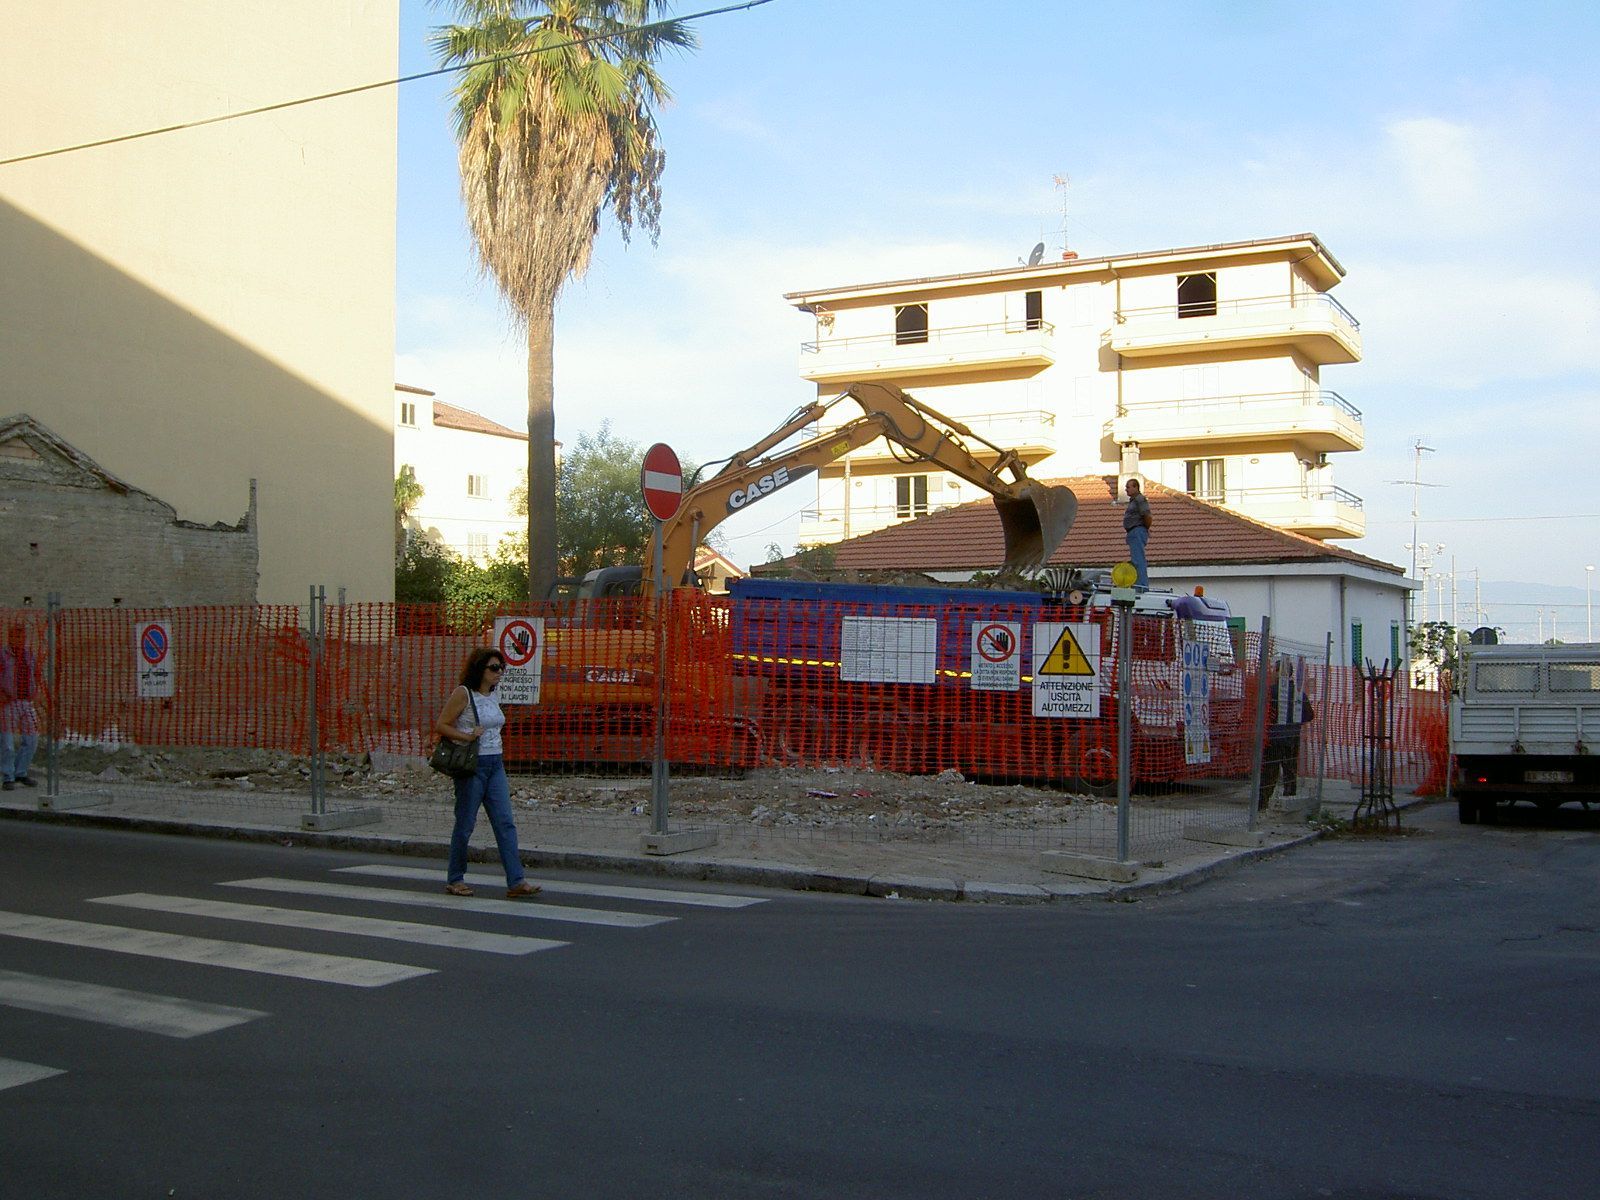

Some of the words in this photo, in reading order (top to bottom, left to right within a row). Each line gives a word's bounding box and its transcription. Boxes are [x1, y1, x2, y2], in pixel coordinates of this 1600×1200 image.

[728, 466, 789, 509] CASE
[514, 685, 539, 693] ADDETTI
[1039, 682, 1094, 692] ATTENZIONE
[1050, 692, 1081, 702] USCITA
[1041, 703, 1093, 713] AUTOMEZZI
